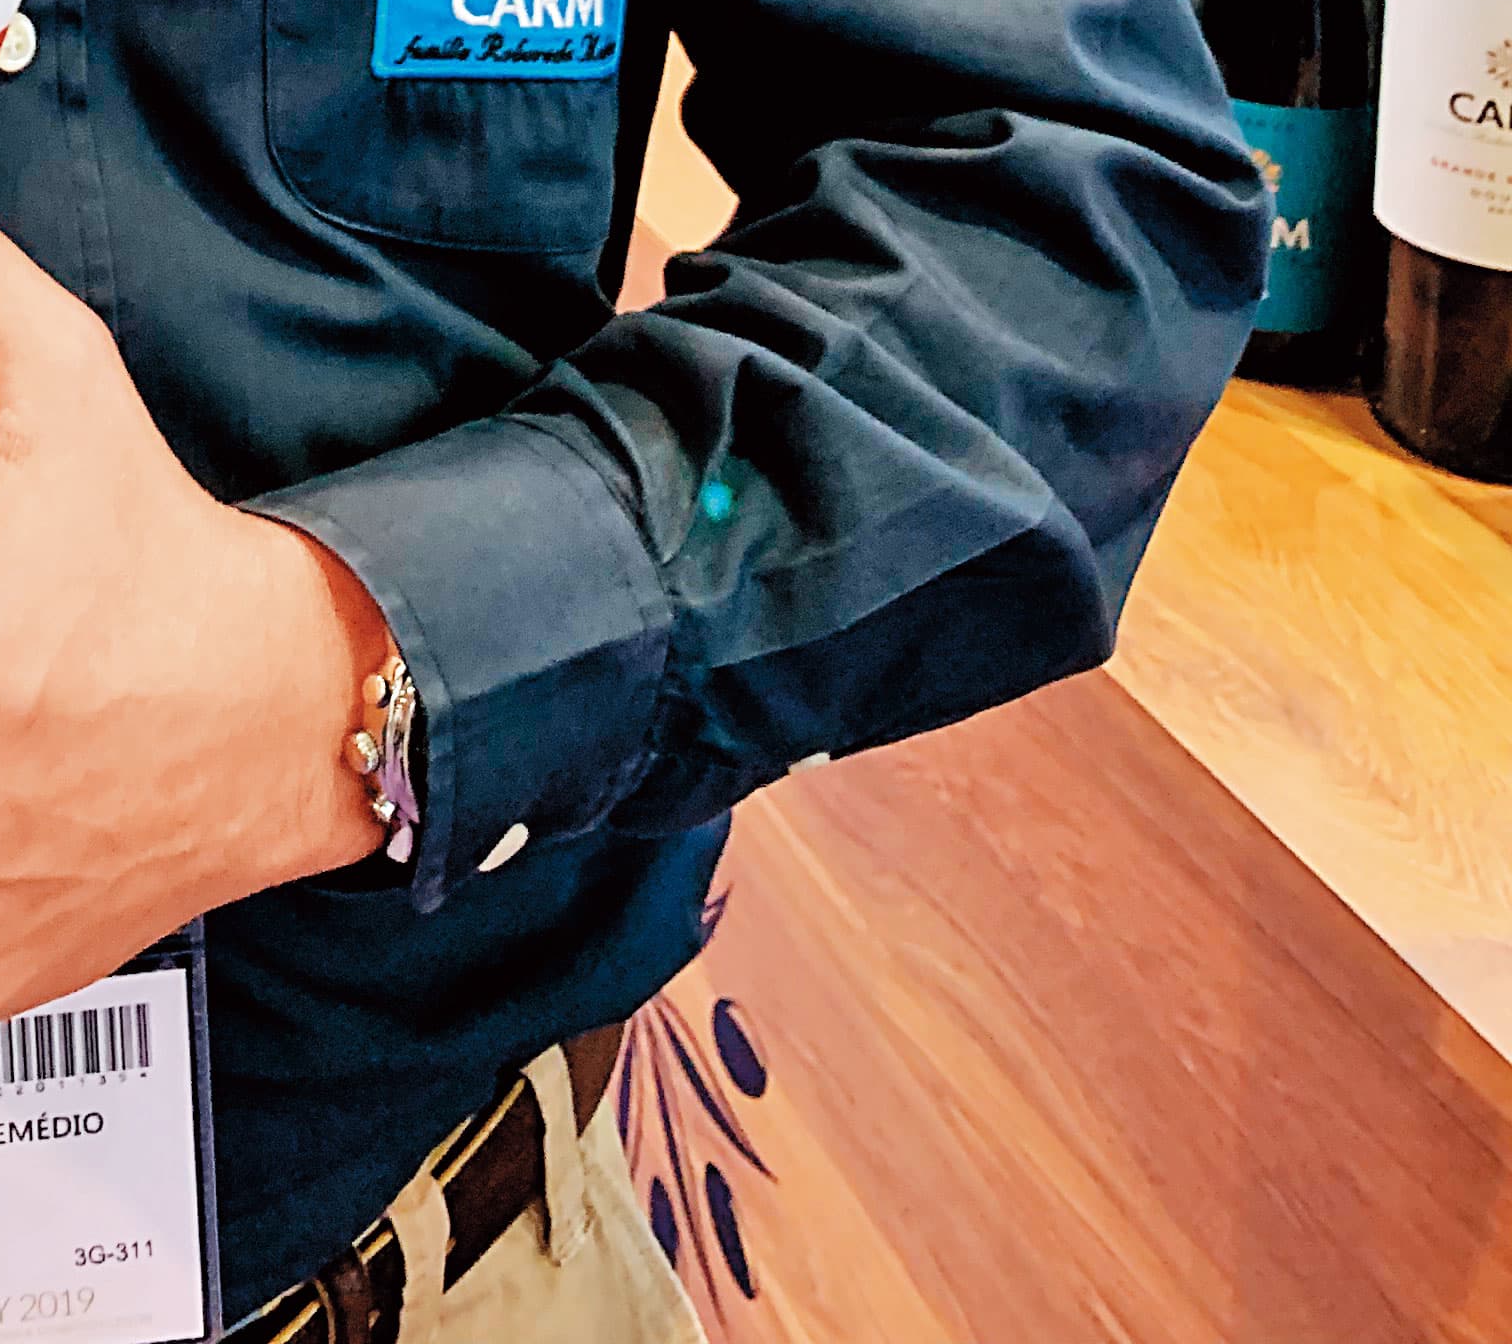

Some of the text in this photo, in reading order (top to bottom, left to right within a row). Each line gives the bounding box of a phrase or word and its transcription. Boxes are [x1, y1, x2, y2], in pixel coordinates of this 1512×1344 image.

[1449, 92, 1512, 130] CA
[73, 1239, 155, 1268] 3G-311
[18, 1286, 96, 1322] 2019
